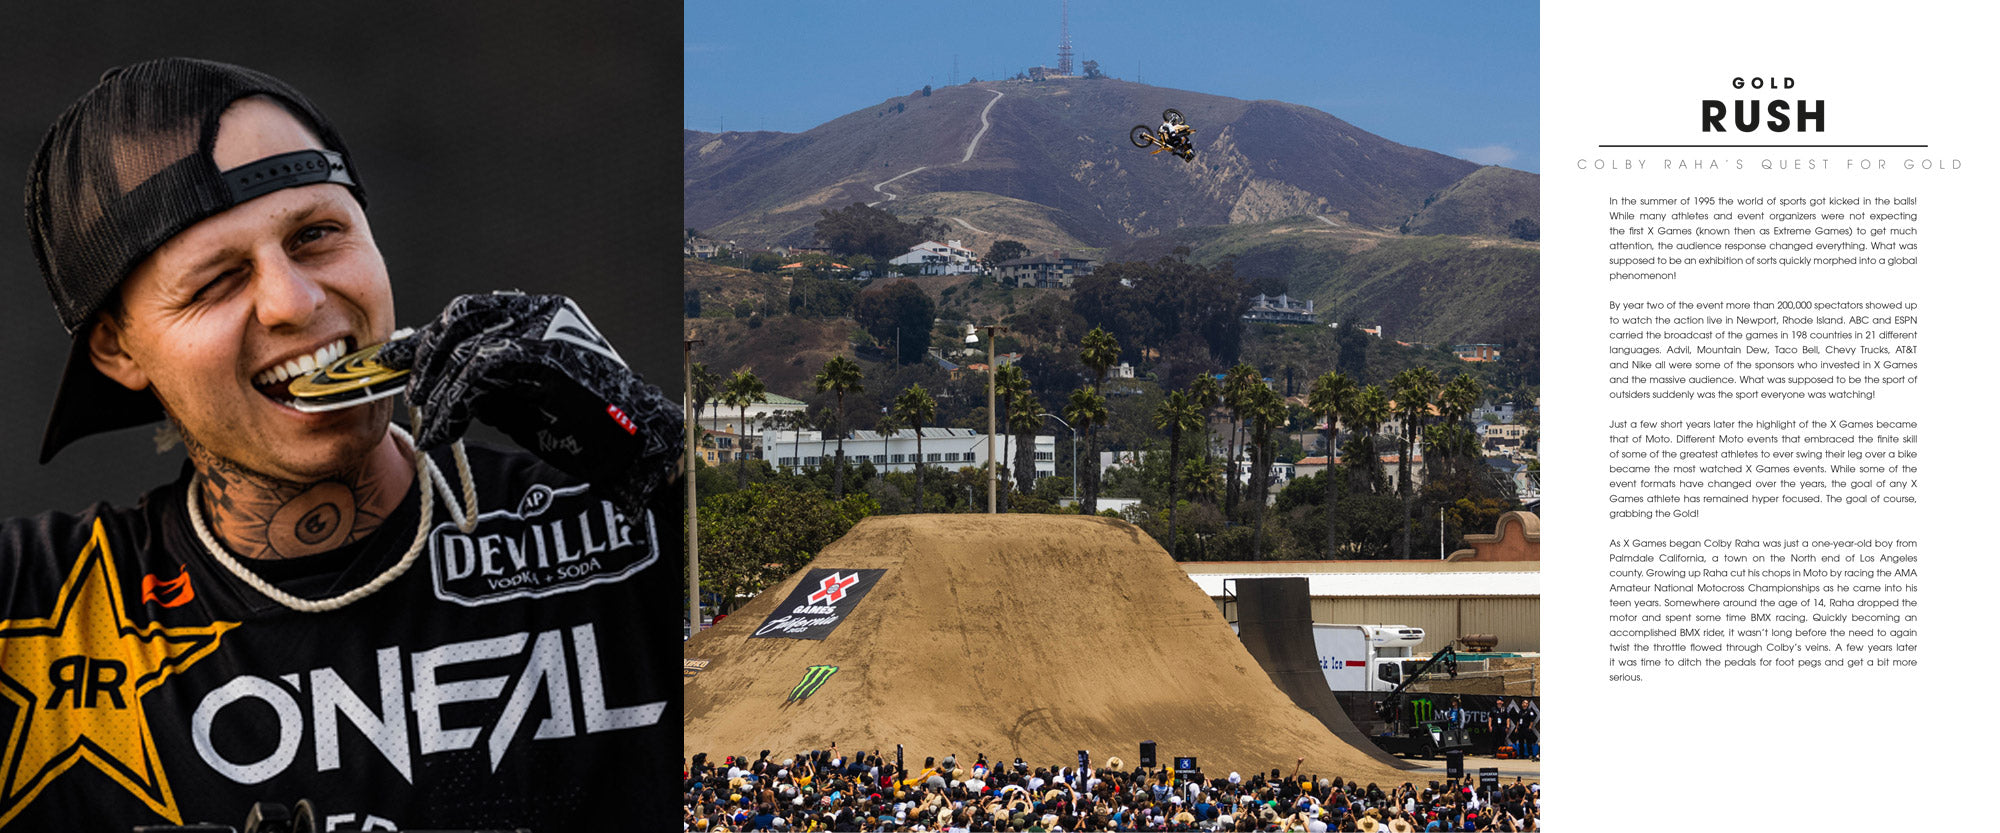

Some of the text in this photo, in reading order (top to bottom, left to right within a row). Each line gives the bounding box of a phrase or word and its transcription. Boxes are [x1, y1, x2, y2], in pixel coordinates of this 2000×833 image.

[608, 404, 636, 431] FIST
[443, 500, 634, 582] DEVILLE
[556, 557, 603, 580] SODA
[792, 605, 837, 615] GAMES
[755, 613, 840, 636] California
[190, 622, 668, 786] O'NEAL
